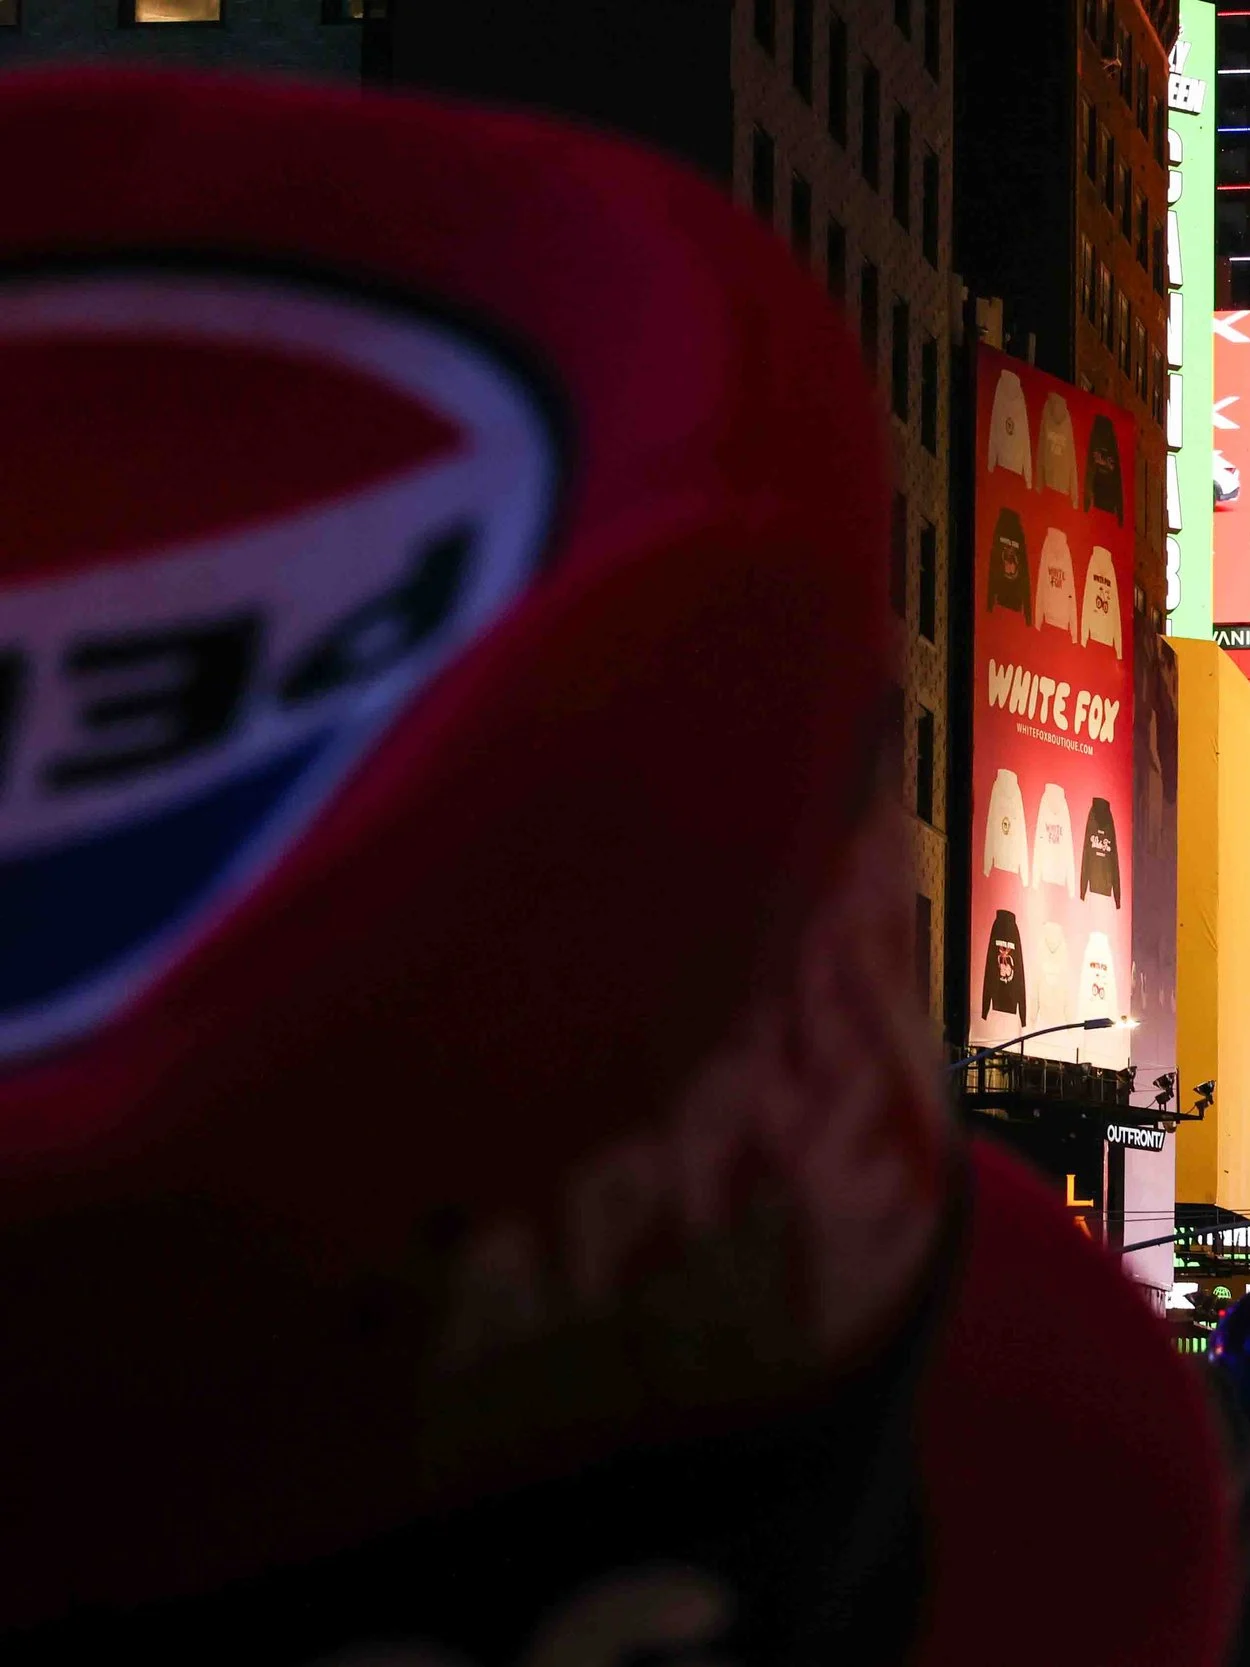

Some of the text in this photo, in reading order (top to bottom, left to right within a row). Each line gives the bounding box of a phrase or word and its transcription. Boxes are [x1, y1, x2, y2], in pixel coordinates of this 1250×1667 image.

[988, 658, 1120, 743] WHITE FOX
[1016, 723, 1094, 756] WHITEFOXBOUTIQUE.COM
